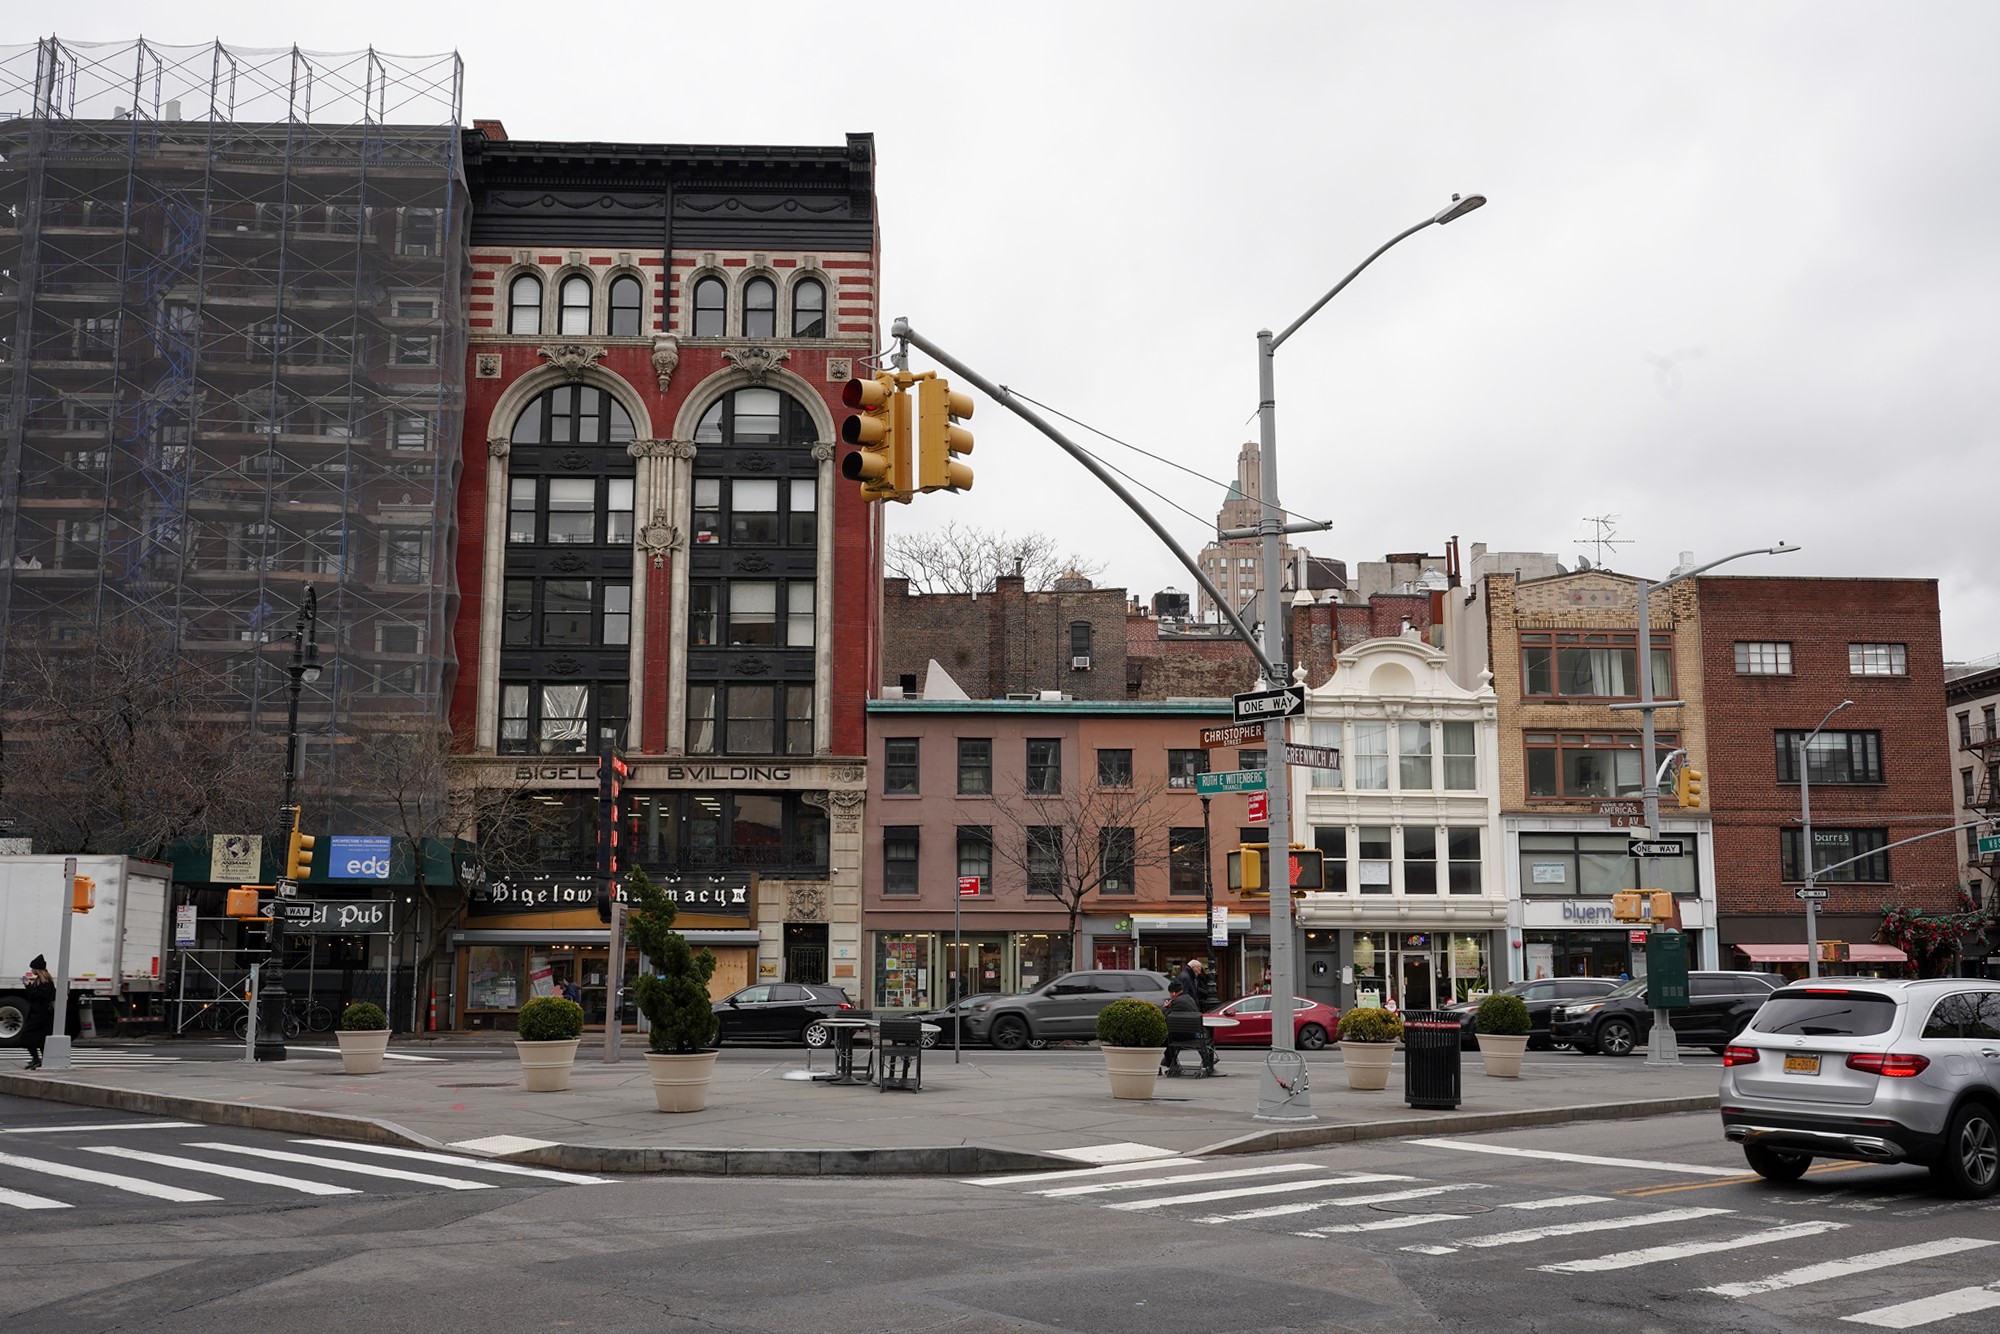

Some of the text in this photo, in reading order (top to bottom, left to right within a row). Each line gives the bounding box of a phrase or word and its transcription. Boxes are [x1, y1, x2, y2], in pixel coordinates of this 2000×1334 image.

[1243, 696, 1294, 713] ONE WAY
[1203, 724, 1262, 743] CHRISTOPHER
[1223, 738, 1242, 747] STREET
[1285, 746, 1338, 768] GREENWICH AV
[1202, 771, 1263, 787] RUTH E WITTENBERG
[1599, 806, 1638, 815] AMERICAS
[1617, 816, 1639, 827] 6 AV
[1636, 845, 1677, 853] ONE WAY
[346, 855, 390, 879] edg
[492, 880, 592, 907] Bigelow
[289, 907, 307, 917] WAY
[337, 904, 384, 928] Pub
